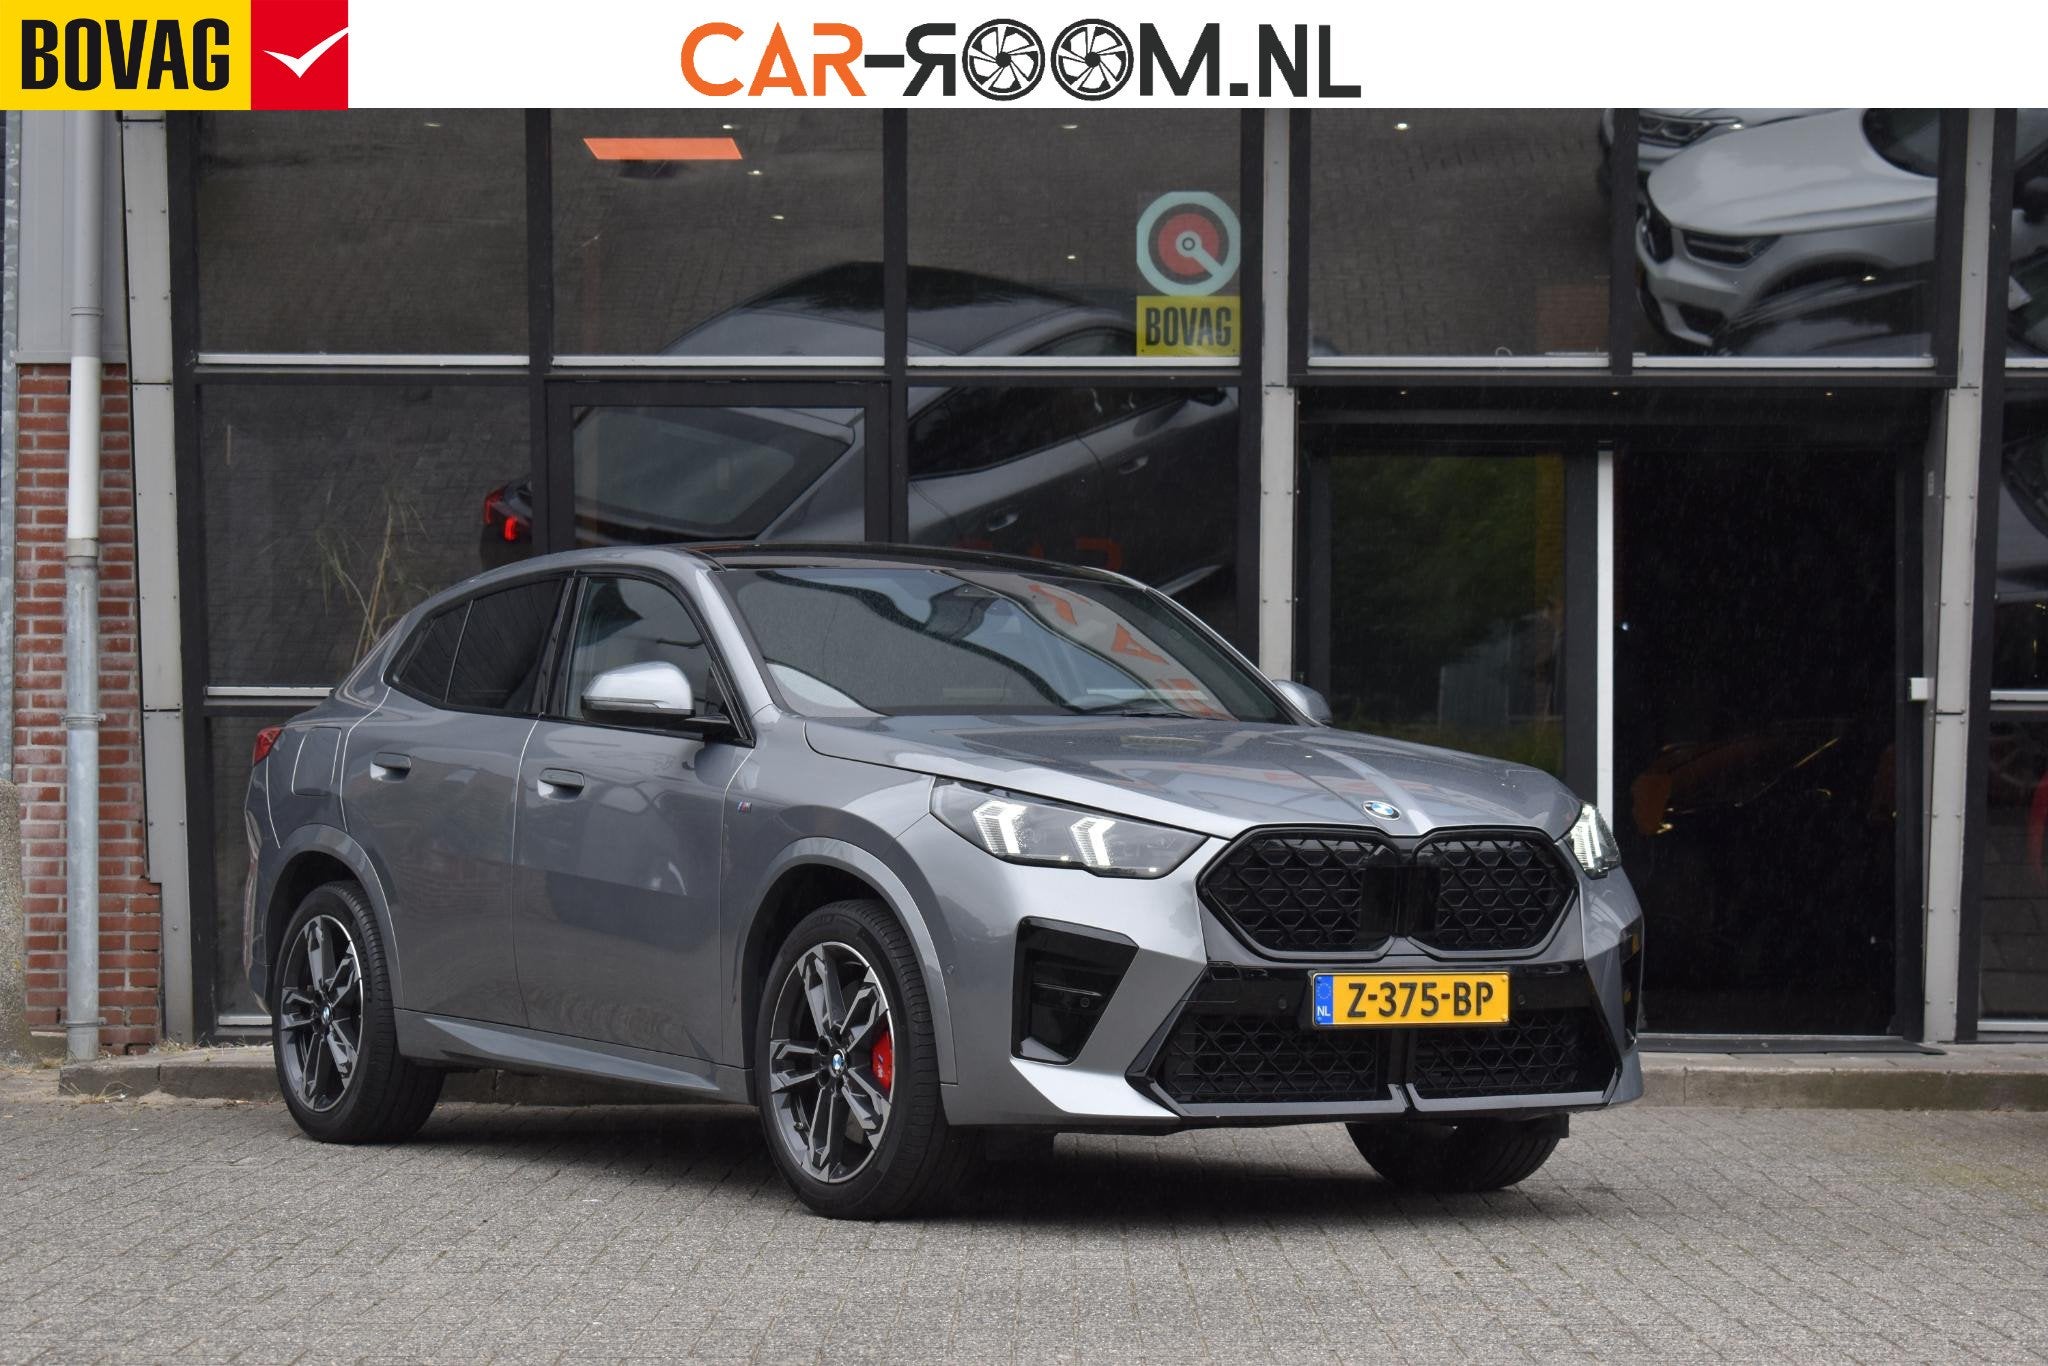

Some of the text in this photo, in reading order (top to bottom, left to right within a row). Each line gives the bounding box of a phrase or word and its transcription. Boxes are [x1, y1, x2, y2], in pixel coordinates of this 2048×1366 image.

[1145, 306, 1232, 346] BOVAG
[1317, 1006, 1331, 1017] NL
[1347, 981, 1494, 1018] Z-375-BP
